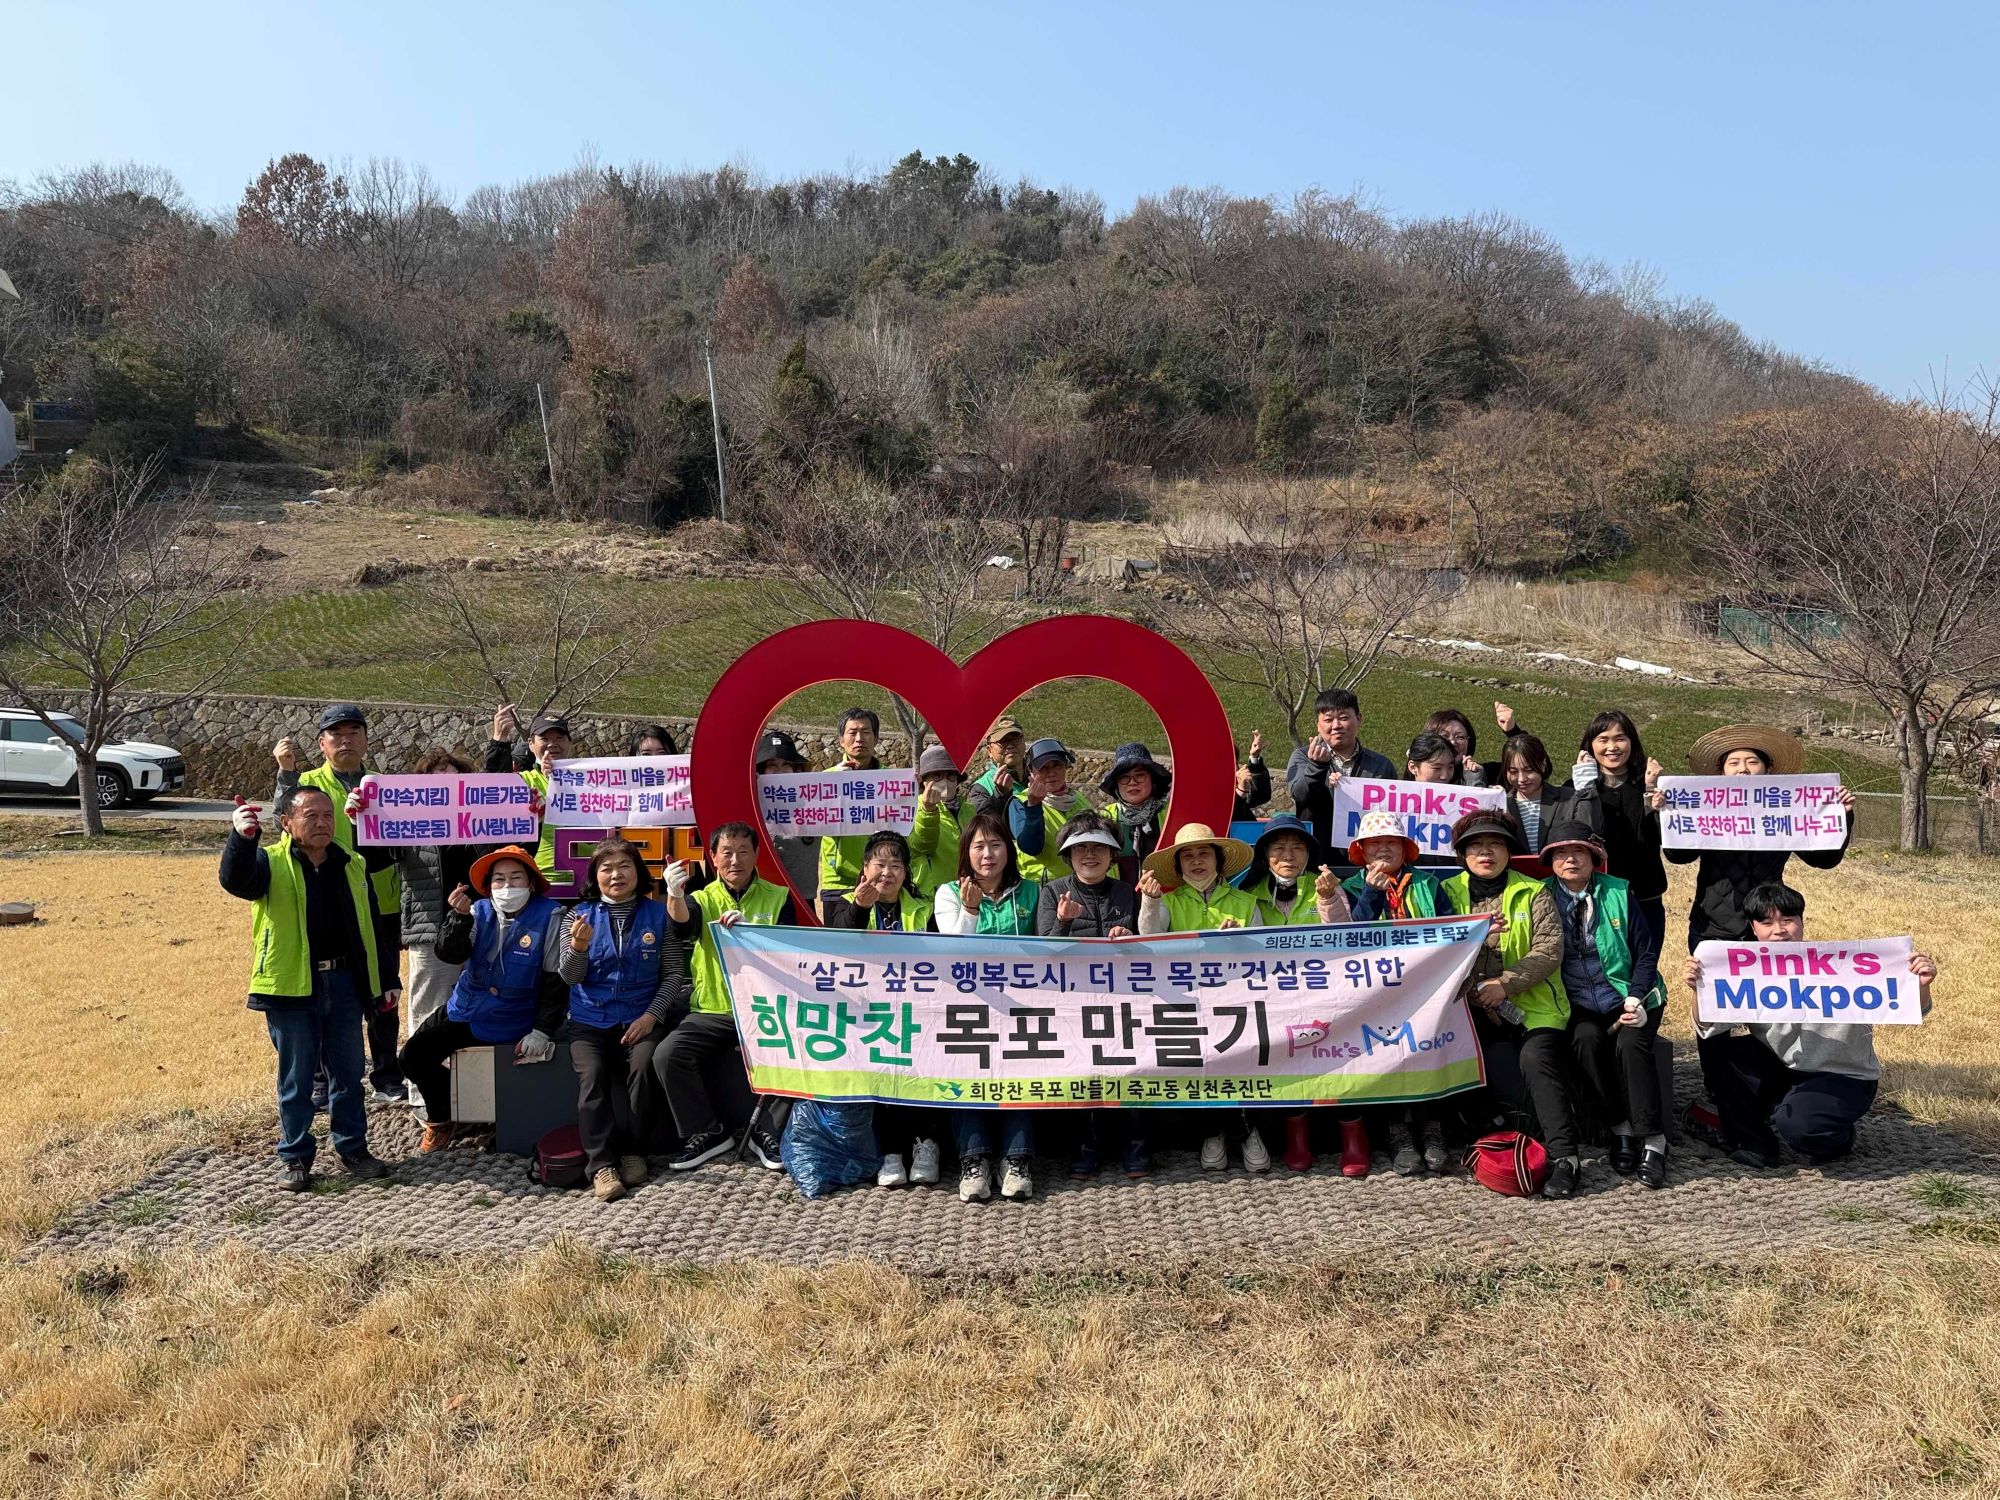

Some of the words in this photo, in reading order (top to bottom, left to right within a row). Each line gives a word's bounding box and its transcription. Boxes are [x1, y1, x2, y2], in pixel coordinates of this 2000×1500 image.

[551, 769, 585, 787] 약속을
[587, 768, 626, 787] 지키고!
[632, 766, 665, 787] 마을을
[551, 792, 577, 813] 서로
[580, 792, 632, 813] 칭찬하고!
[638, 792, 663, 813] 함께
[666, 791, 693, 811] 나누
[763, 785, 797, 803] 약속을
[799, 783, 838, 802] 지키고!
[842, 781, 875, 800] 마을을
[877, 780, 915, 799] 가꾸고!
[1362, 784, 1480, 816] Pink's
[1664, 788, 1700, 809] 약속을
[1704, 786, 1748, 808] 지키고!
[1754, 786, 1792, 808] 마을을
[364, 814, 450, 840] N(칭찬운동)
[458, 812, 534, 838] K(사랑나눔)
[766, 808, 791, 825] 서로
[793, 807, 844, 826] 칭찬하고!
[849, 805, 875, 825] 함께
[877, 805, 915, 823] 나누고!
[1668, 814, 1696, 835] 서로
[1697, 814, 1755, 836] 칭찬하고!
[1761, 814, 1792, 836] 함께
[1794, 814, 1842, 836] 나누고!
[1265, 935, 1306, 949] 희망찬
[1310, 932, 1343, 949] 도약!
[1345, 930, 1386, 948] 청년이
[1391, 929, 1419, 946] 찾는
[1423, 928, 1438, 944] 큰
[1442, 926, 1469, 942] 목포
[1727, 946, 1881, 976] Pink's
[882, 961, 939, 993] 싶은
[951, 961, 1075, 993] 행복도시,
[1089, 961, 1114, 993] 더
[1127, 961, 1156, 992] 큰
[1344, 956, 1404, 989] 위한
[1714, 978, 1900, 1018] Mokpo!
[751, 994, 922, 1067] 희망찬
[936, 1003, 1065, 1070] 목포
[1081, 1000, 1271, 1069] 만들기
[970, 1080, 1023, 1101] 희망찬
[1028, 1080, 1064, 1100] 목포
[1070, 1080, 1122, 1100] 만들기
[1127, 1080, 1179, 1100] 죽교동
[1185, 1079, 1273, 1099] 실천추진단
